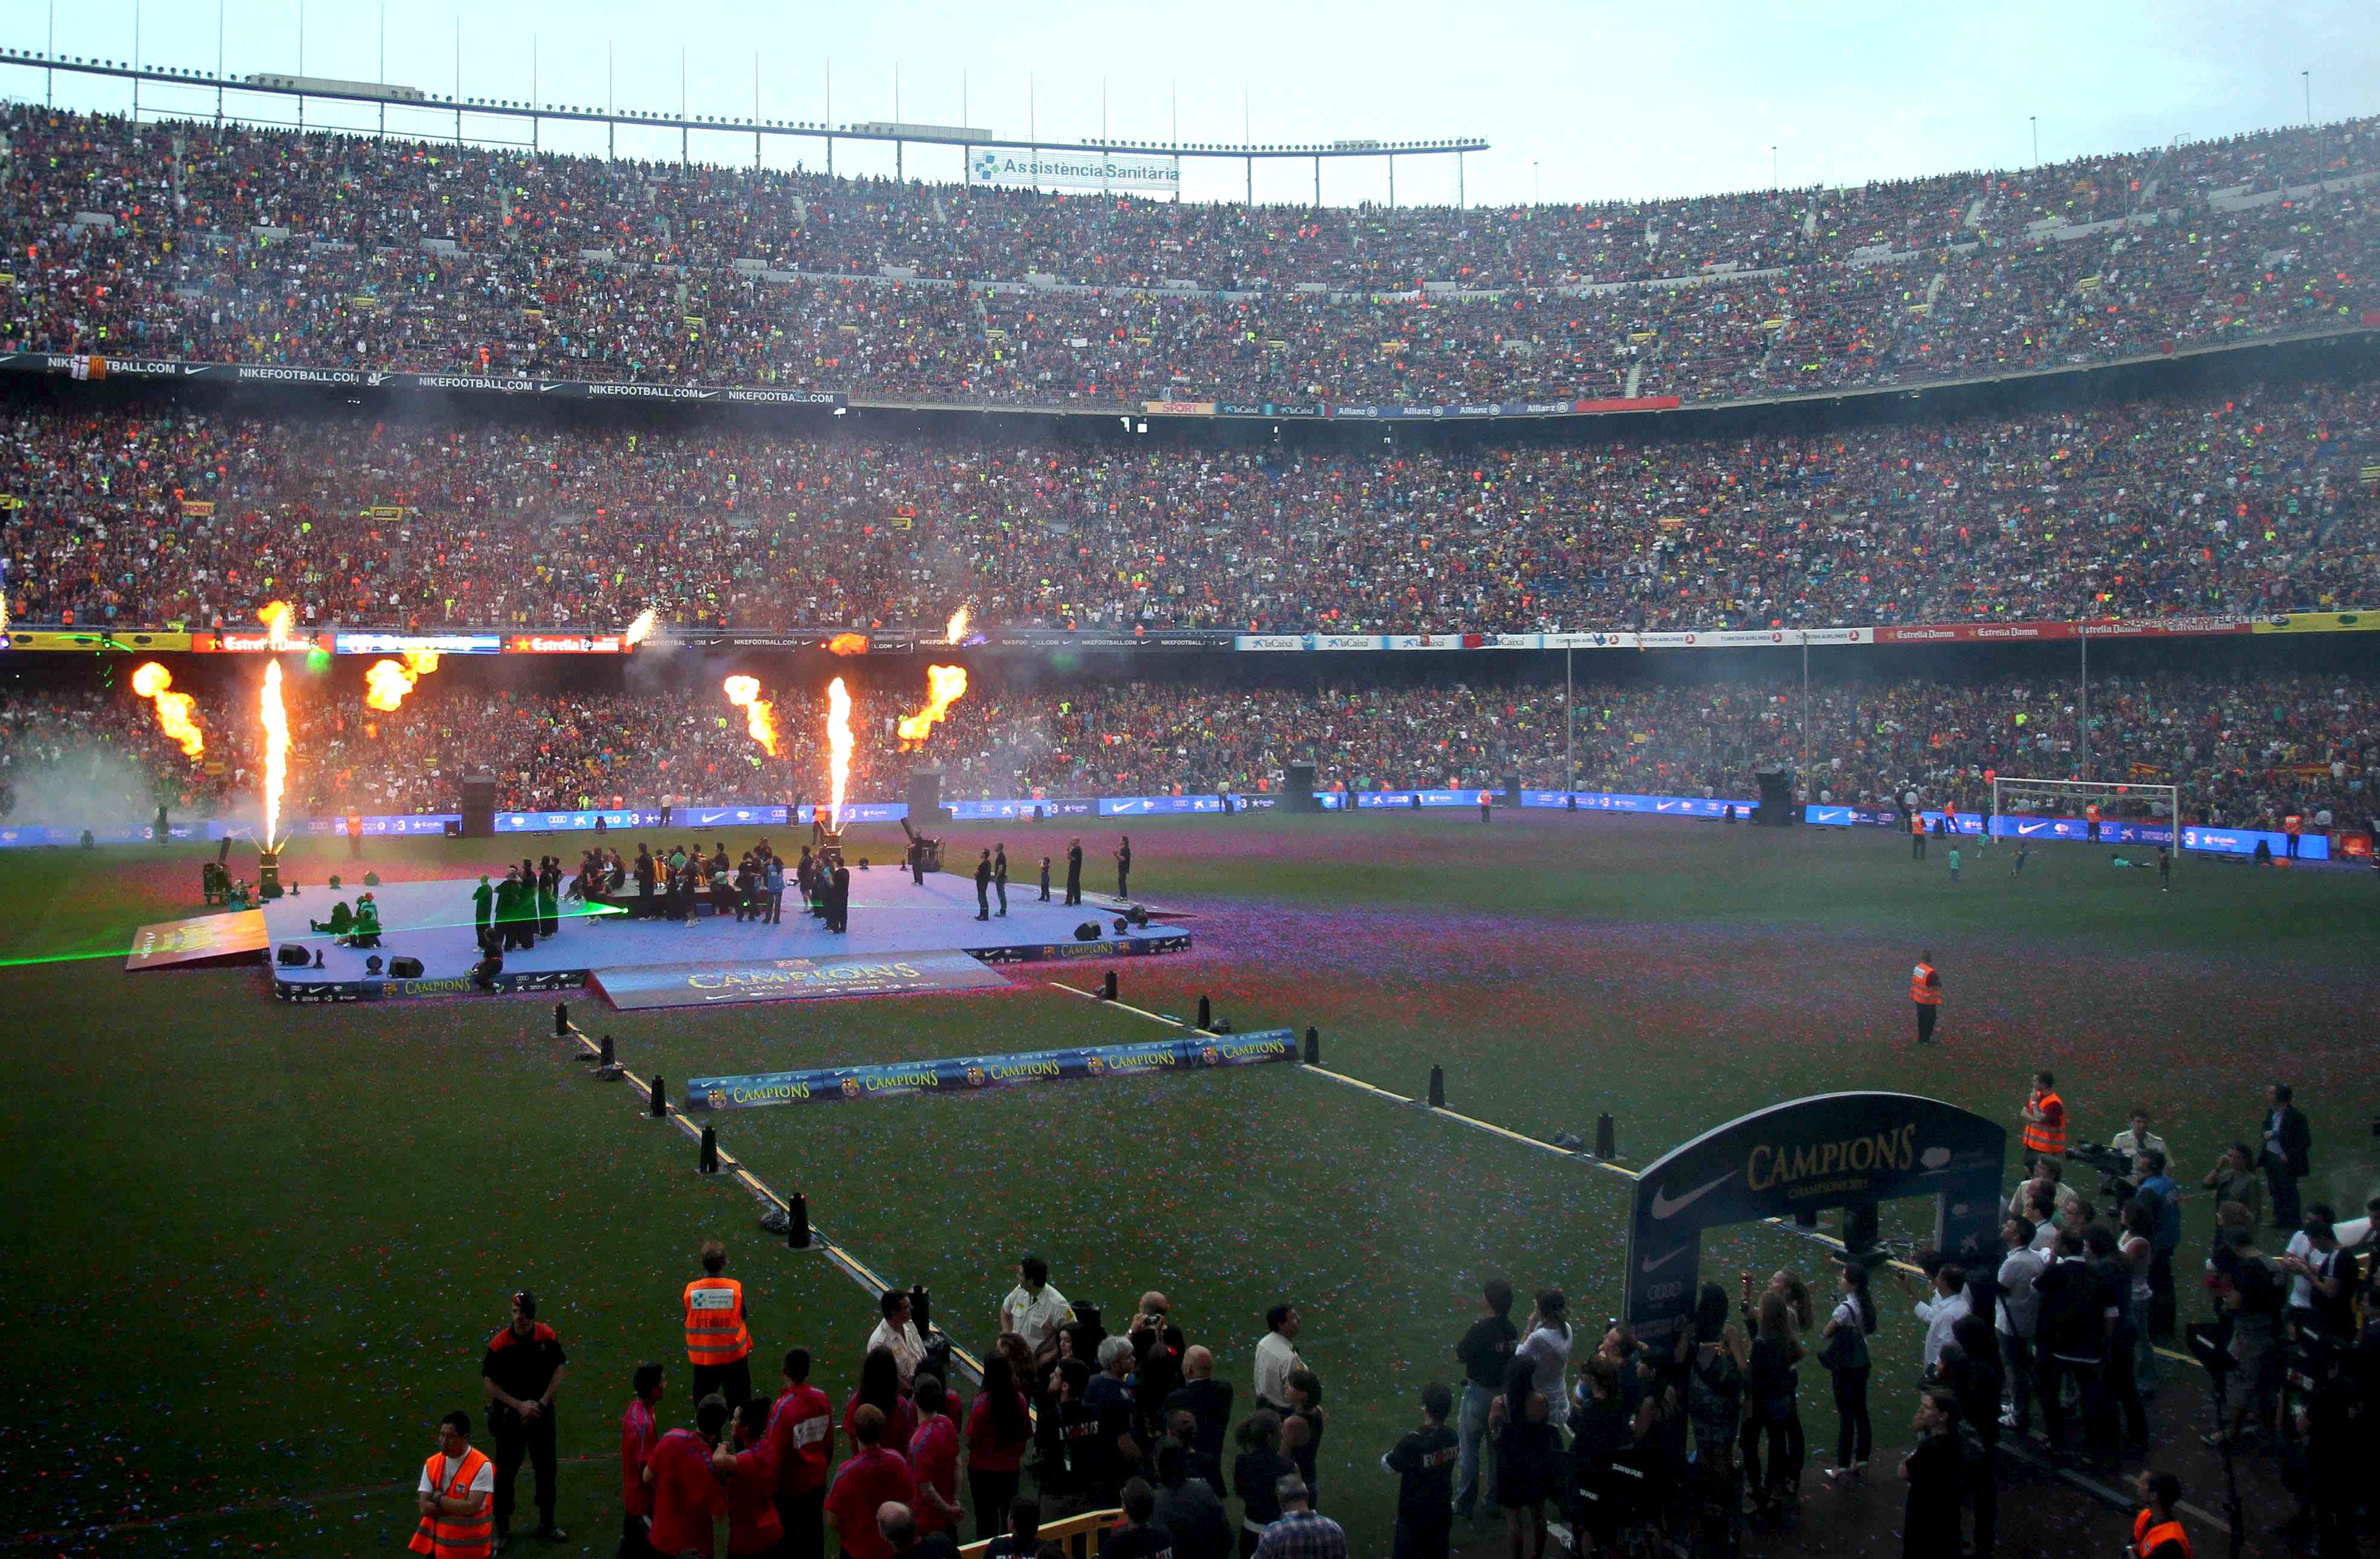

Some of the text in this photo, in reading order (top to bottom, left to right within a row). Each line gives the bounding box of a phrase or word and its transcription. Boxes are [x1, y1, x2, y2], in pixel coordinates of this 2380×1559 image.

[1004, 158, 1179, 181] Assistència Sanitària
[48, 357, 175, 373] NIKETBALL.COM
[419, 378, 532, 390] NIKEFOOTBALL.COM
[589, 386, 698, 398] NIKEFOOTBALL.COM
[1163, 403, 1197, 413] SPORT
[1928, 630, 1955, 638] Damm
[1978, 627, 2038, 637] Estrella Damm
[532, 638, 579, 651] Estrella
[1061, 941, 1114, 957] CAMPIONS
[687, 963, 921, 989] CAMPIONS
[405, 977, 470, 995] CAMPIONS
[1222, 1037, 1285, 1059] CAMPIONS
[1109, 1049, 1175, 1070] CAMPIONS
[990, 1059, 1060, 1081] CAMPIONS
[865, 1069, 938, 1091] CAMPIONS
[733, 1082, 810, 1103] CAMPIONS
[1747, 1123, 1916, 1192] CAMPIONS
[696, 1317, 731, 1328] STEWARD
[1612, 1462, 1644, 1478] SHURE
